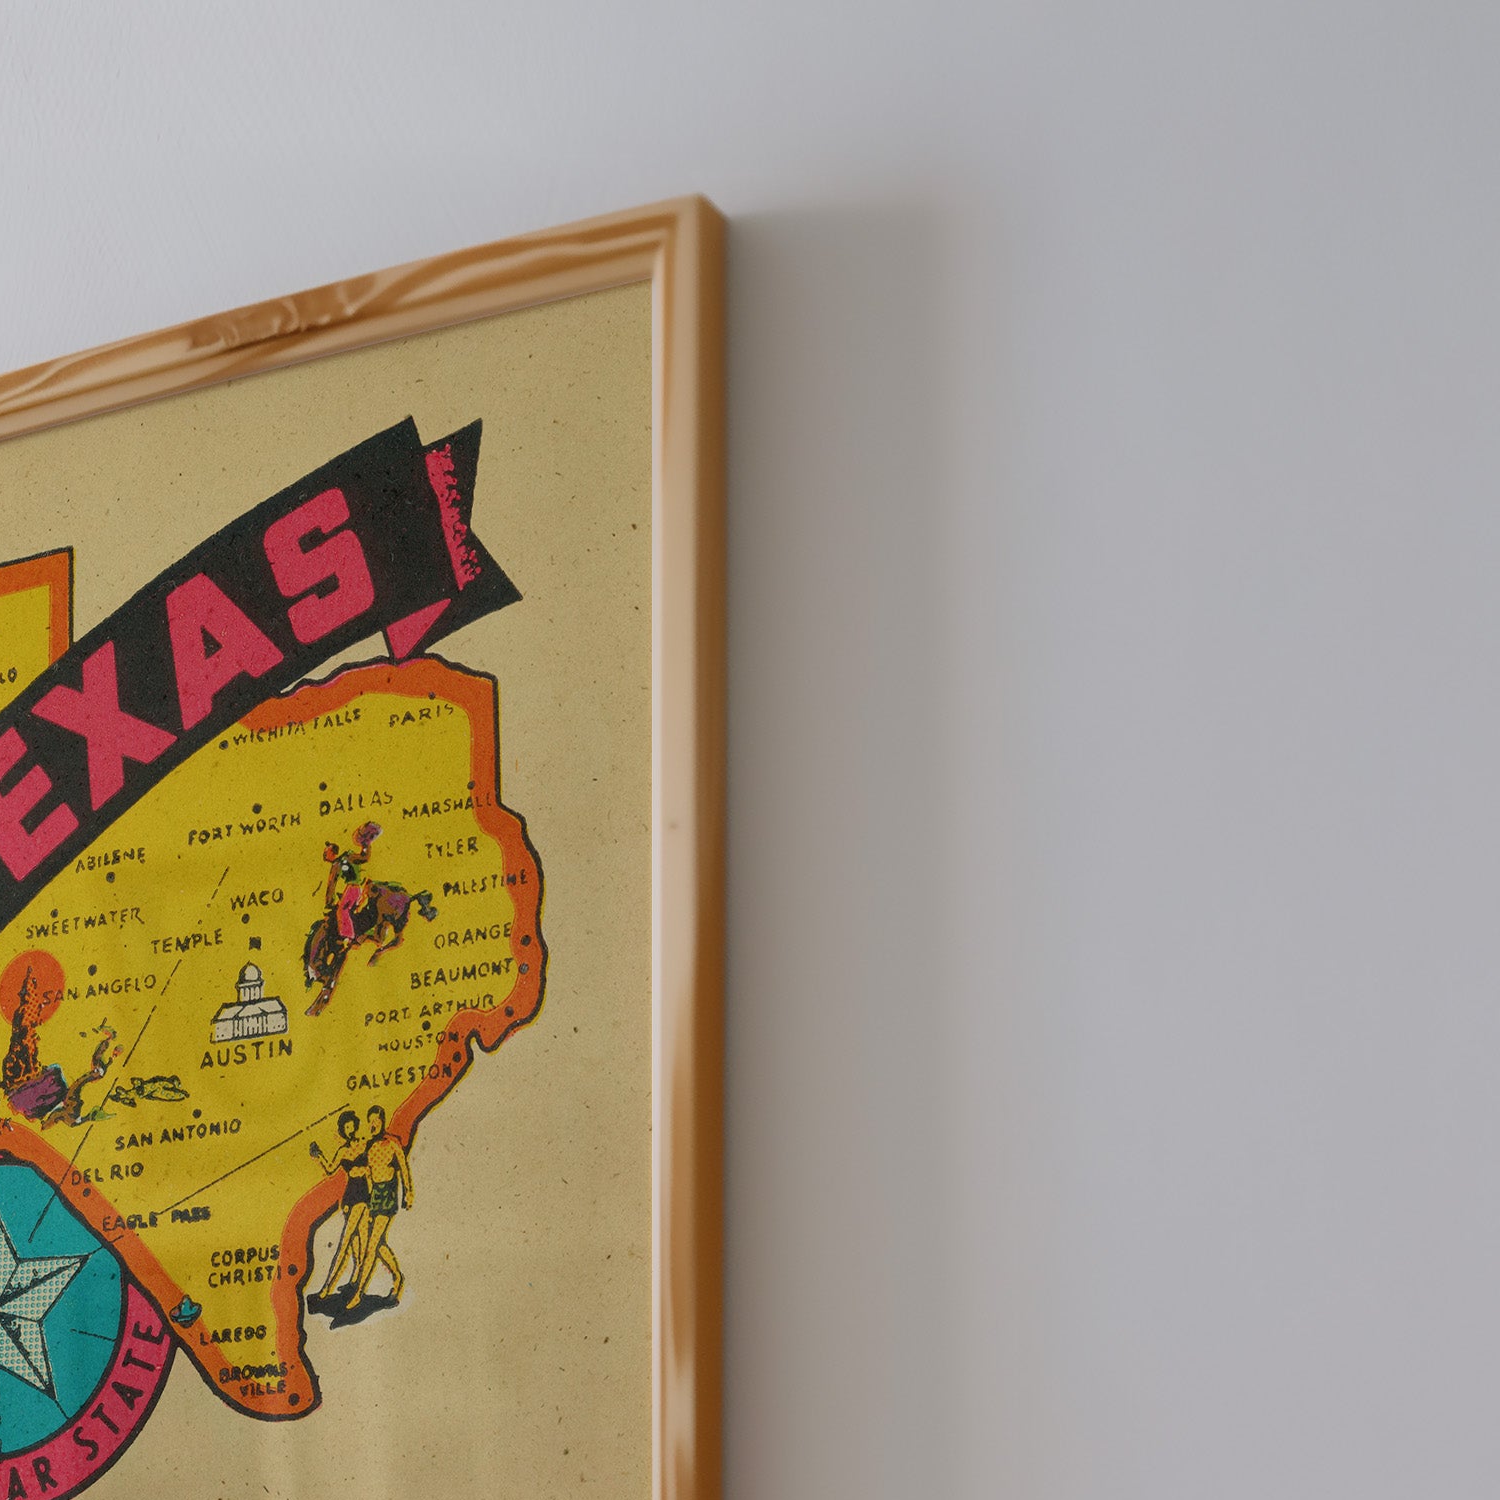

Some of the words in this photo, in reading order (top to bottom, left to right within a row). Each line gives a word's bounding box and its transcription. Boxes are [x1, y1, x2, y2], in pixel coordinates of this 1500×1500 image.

[389, 703, 454, 728] PARIS
[233, 720, 306, 745] WICHITA
[319, 790, 393, 817] DALLAS
[402, 792, 492, 819] MARSHALL
[188, 824, 233, 846] FORT
[238, 812, 301, 835] WORTH
[75, 847, 146, 873] ABILENE
[425, 836, 479, 859] TYLER
[442, 868, 528, 897] PALESTINE
[230, 888, 284, 911] WACO
[25, 907, 145, 939] SWEETWATER
[434, 922, 511, 950] ORANGE
[150, 928, 224, 954] TEMPLE
[410, 957, 514, 990] BEAUMONT
[43, 986, 78, 1006] SAN
[86, 974, 156, 999] ANGELO
[364, 1006, 410, 1027] PORT
[419, 993, 496, 1018] ARTHUR
[200, 1038, 293, 1070] AUSTIN
[378, 1030, 460, 1052] HOUSTON
[346, 1062, 453, 1092] GALVESTON
[114, 1133, 154, 1151] SAN
[159, 1118, 242, 1144] ANTONIO
[70, 1167, 104, 1187] DEL
[109, 1162, 144, 1181] RIO
[102, 1211, 158, 1232] EAGLE
[210, 1244, 280, 1268] CORPUS
[208, 1265, 282, 1288] CHRISTI
[199, 1325, 267, 1346] LAREDO
[72, 1320, 166, 1461] STATE
[239, 1380, 287, 1397] VILLE
